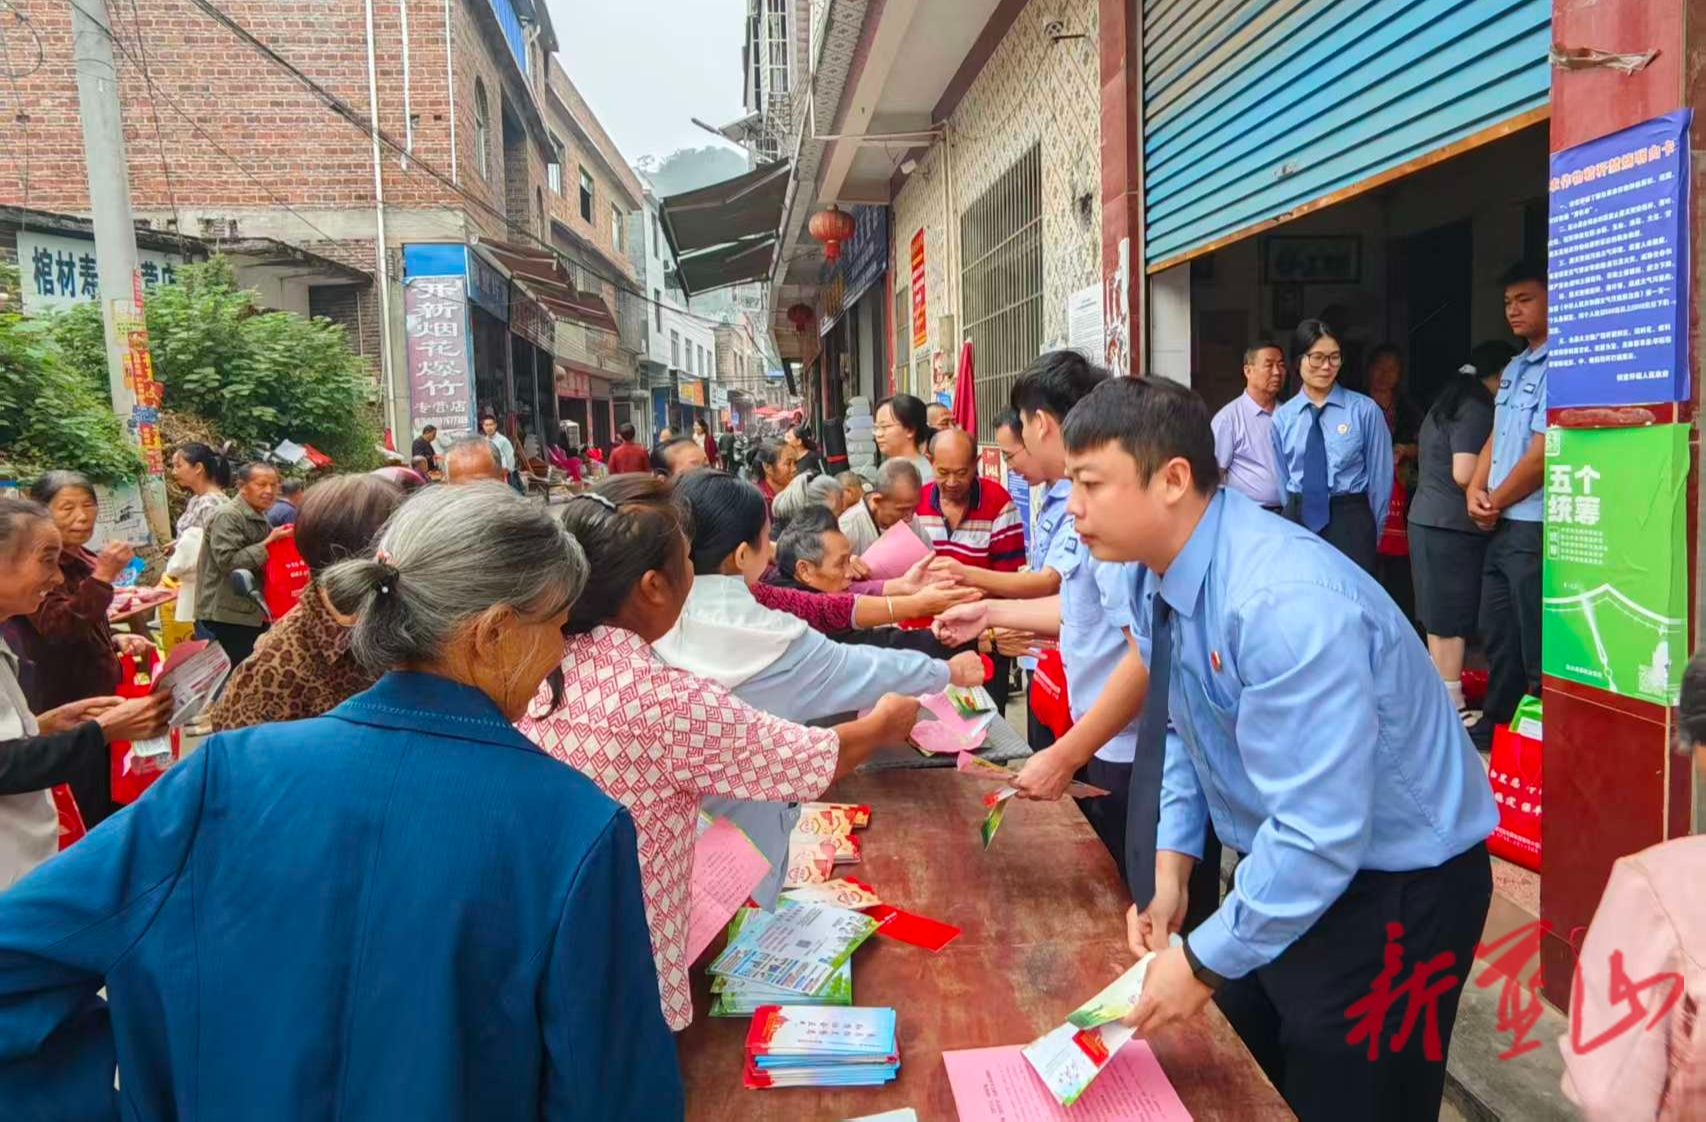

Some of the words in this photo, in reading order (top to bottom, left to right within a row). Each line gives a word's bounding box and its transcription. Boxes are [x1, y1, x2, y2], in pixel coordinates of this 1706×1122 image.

[414, 401, 467, 413] 专营店
[1548, 465, 1600, 494] 五个
[1548, 495, 1601, 525] 统筹
